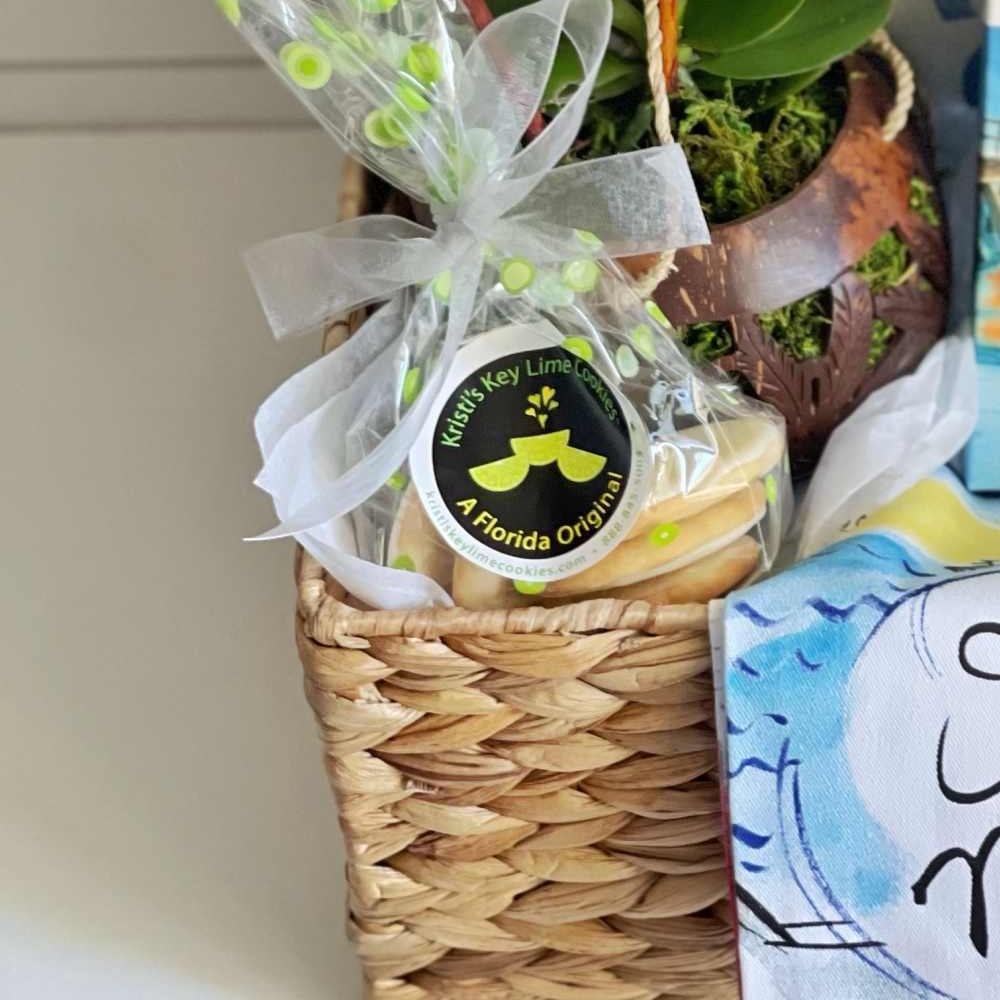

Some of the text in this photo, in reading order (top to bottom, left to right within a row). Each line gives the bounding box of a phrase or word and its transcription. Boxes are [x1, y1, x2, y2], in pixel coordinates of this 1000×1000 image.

[440, 387, 485, 448] Kristi's
[480, 365, 520, 394] Key
[526, 357, 573, 377] Lime
[457, 471, 624, 551] A Florida Original
